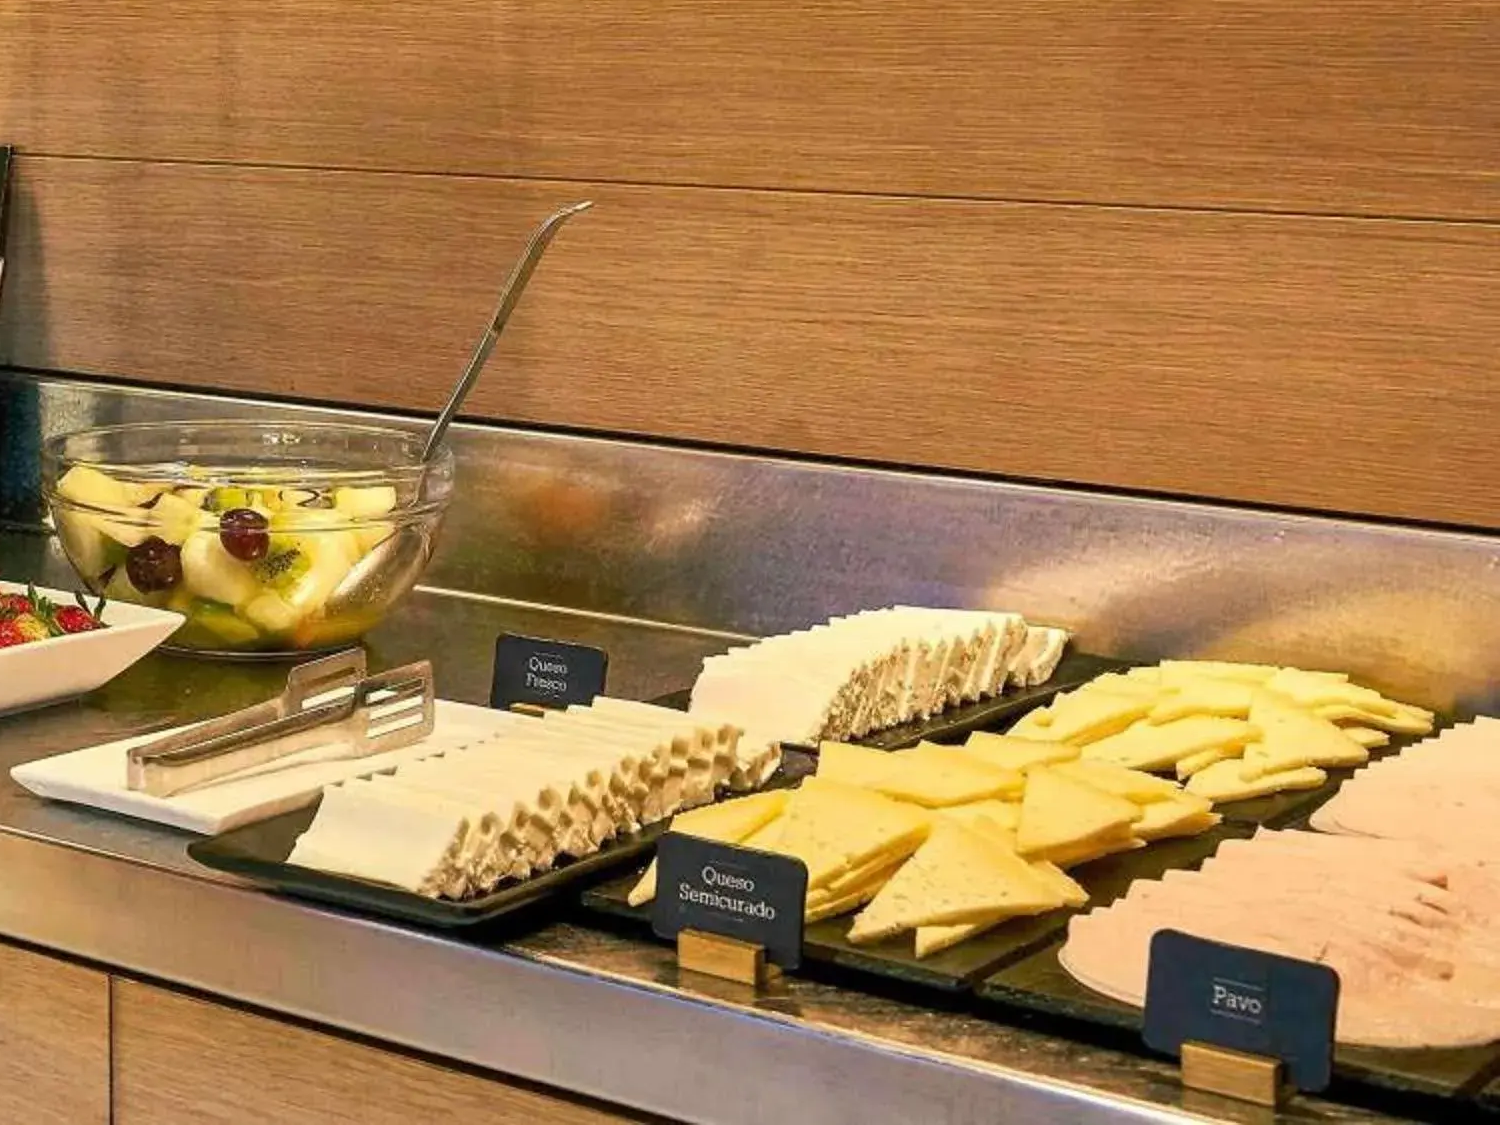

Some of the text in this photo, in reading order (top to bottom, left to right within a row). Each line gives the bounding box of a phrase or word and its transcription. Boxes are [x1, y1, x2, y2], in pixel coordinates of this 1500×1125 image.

[701, 866, 755, 892] Queso
[678, 882, 777, 920] Semicurado
[1212, 984, 1262, 1014] Pavo
